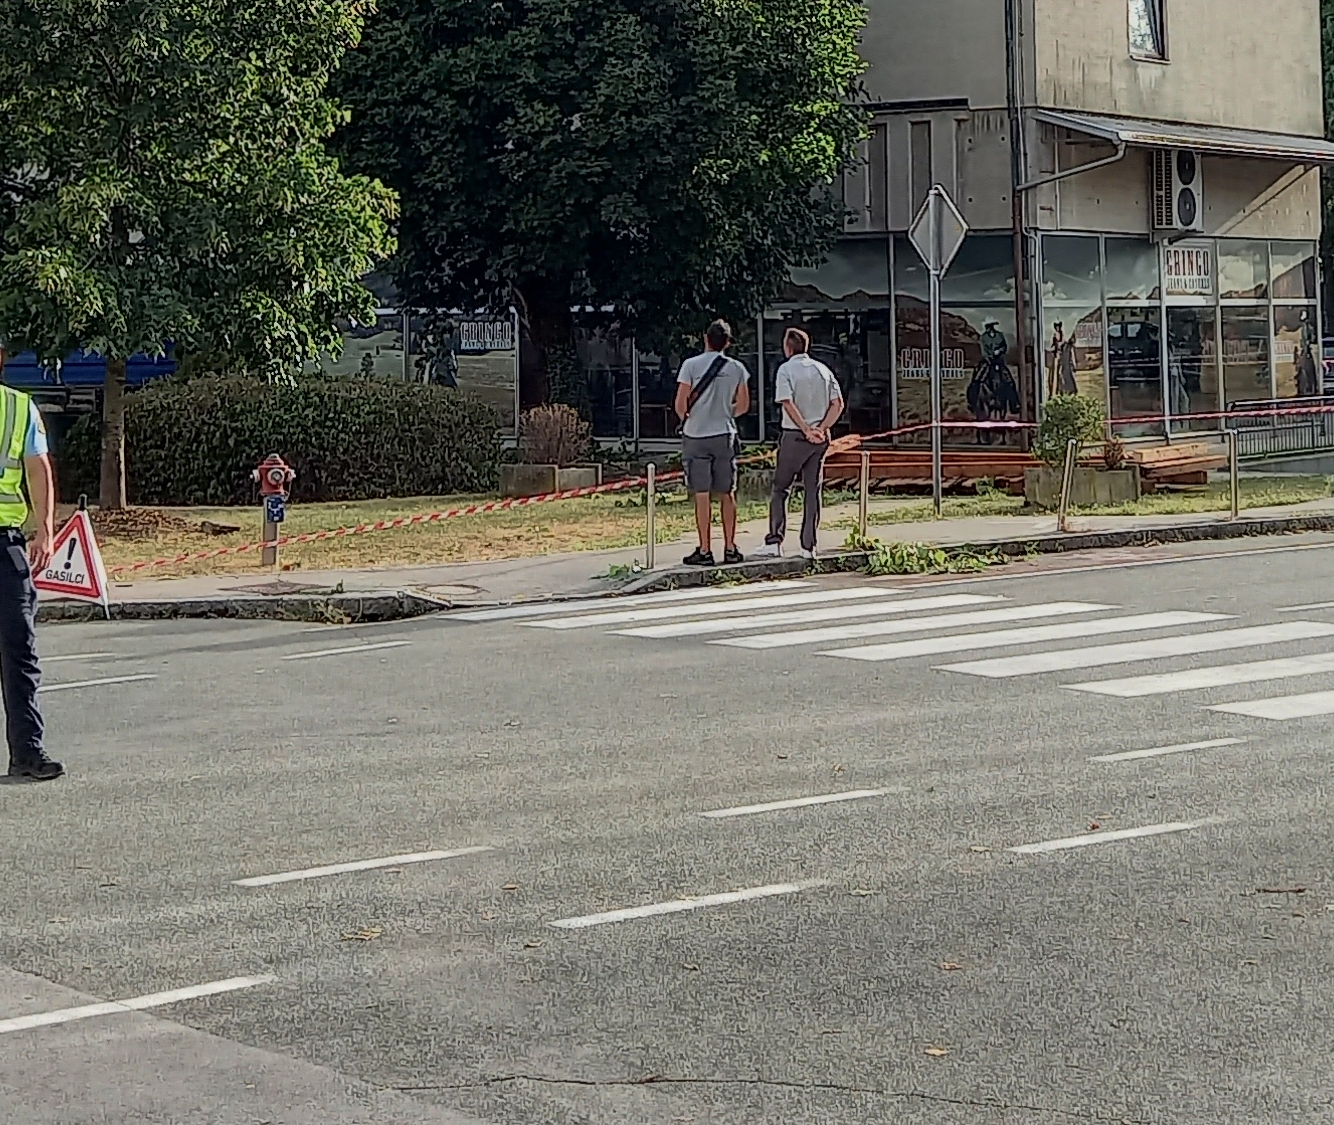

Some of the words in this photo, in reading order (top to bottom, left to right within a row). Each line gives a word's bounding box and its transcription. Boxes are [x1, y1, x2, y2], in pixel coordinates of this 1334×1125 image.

[1166, 249, 1210, 277] GRINGO
[460, 321, 512, 342] GRINGO
[900, 348, 965, 369] GRIGO
[45, 569, 85, 586] GASILCI
